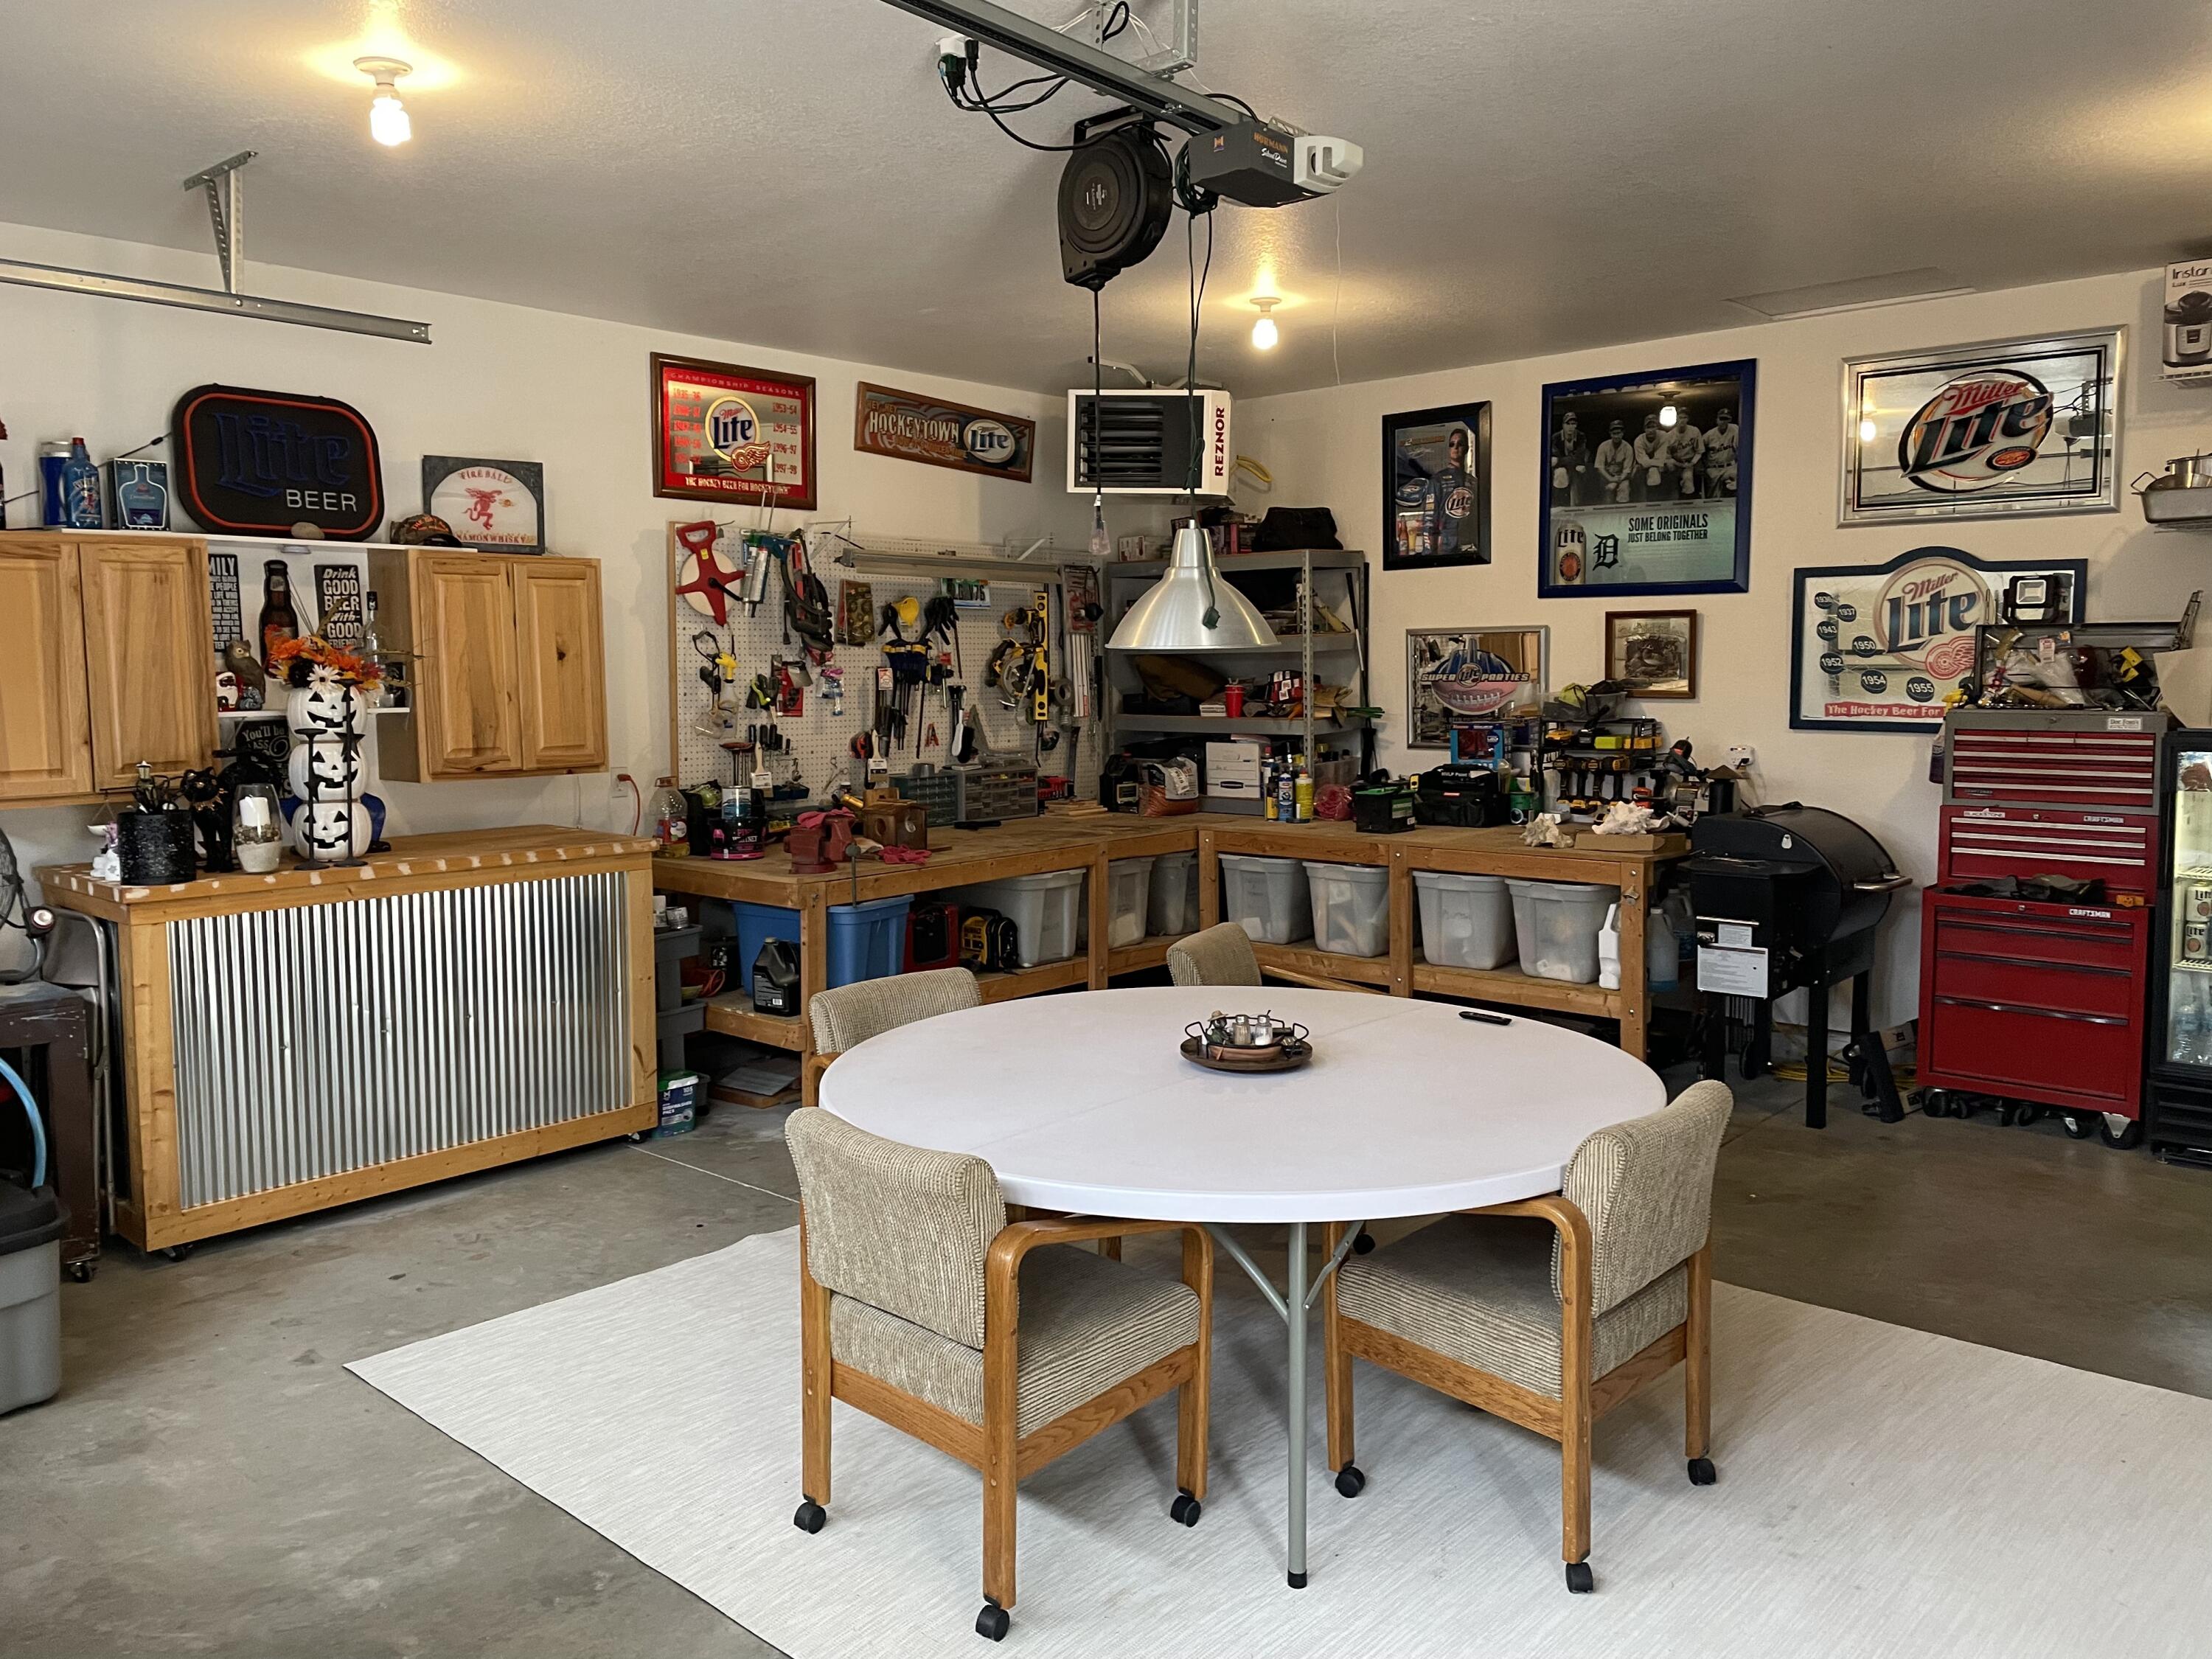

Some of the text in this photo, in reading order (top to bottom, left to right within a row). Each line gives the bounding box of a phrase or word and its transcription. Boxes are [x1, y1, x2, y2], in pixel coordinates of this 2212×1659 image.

[756, 384, 800, 397] SEASONS
[1942, 381, 2029, 416] Miller
[712, 416, 752, 450] Lite
[869, 411, 959, 443] HOCKEYTOWN
[1899, 392, 2053, 479] Lite
[969, 429, 1009, 453] Lite
[1214, 407, 1225, 476] REZNOR
[211, 411, 351, 499] Lite
[738, 481, 749, 491] FOR
[286, 489, 358, 512] BEER
[1628, 513, 1708, 532] SOME ORIGINALS
[1557, 529, 1584, 547] Lite
[1627, 529, 1708, 543] JUST BELONG TOGETHER
[323, 567, 356, 579] Drink
[323, 580, 358, 595] GOOD
[1902, 572, 1958, 601] Miller
[1818, 625, 1837, 633] 1943
[1885, 589, 1978, 653] Lite
[327, 622, 364, 639] GOOD
[1854, 641, 1876, 650] 1950
[1821, 658, 1843, 667] 1952
[1421, 673, 1530, 682] SUPER PARTIES
[1862, 675, 1886, 685] 1954
[1907, 681, 1933, 694] 1955
[1826, 705, 1941, 717] The Hockey Beer For
[242, 725, 271, 742] You'll
